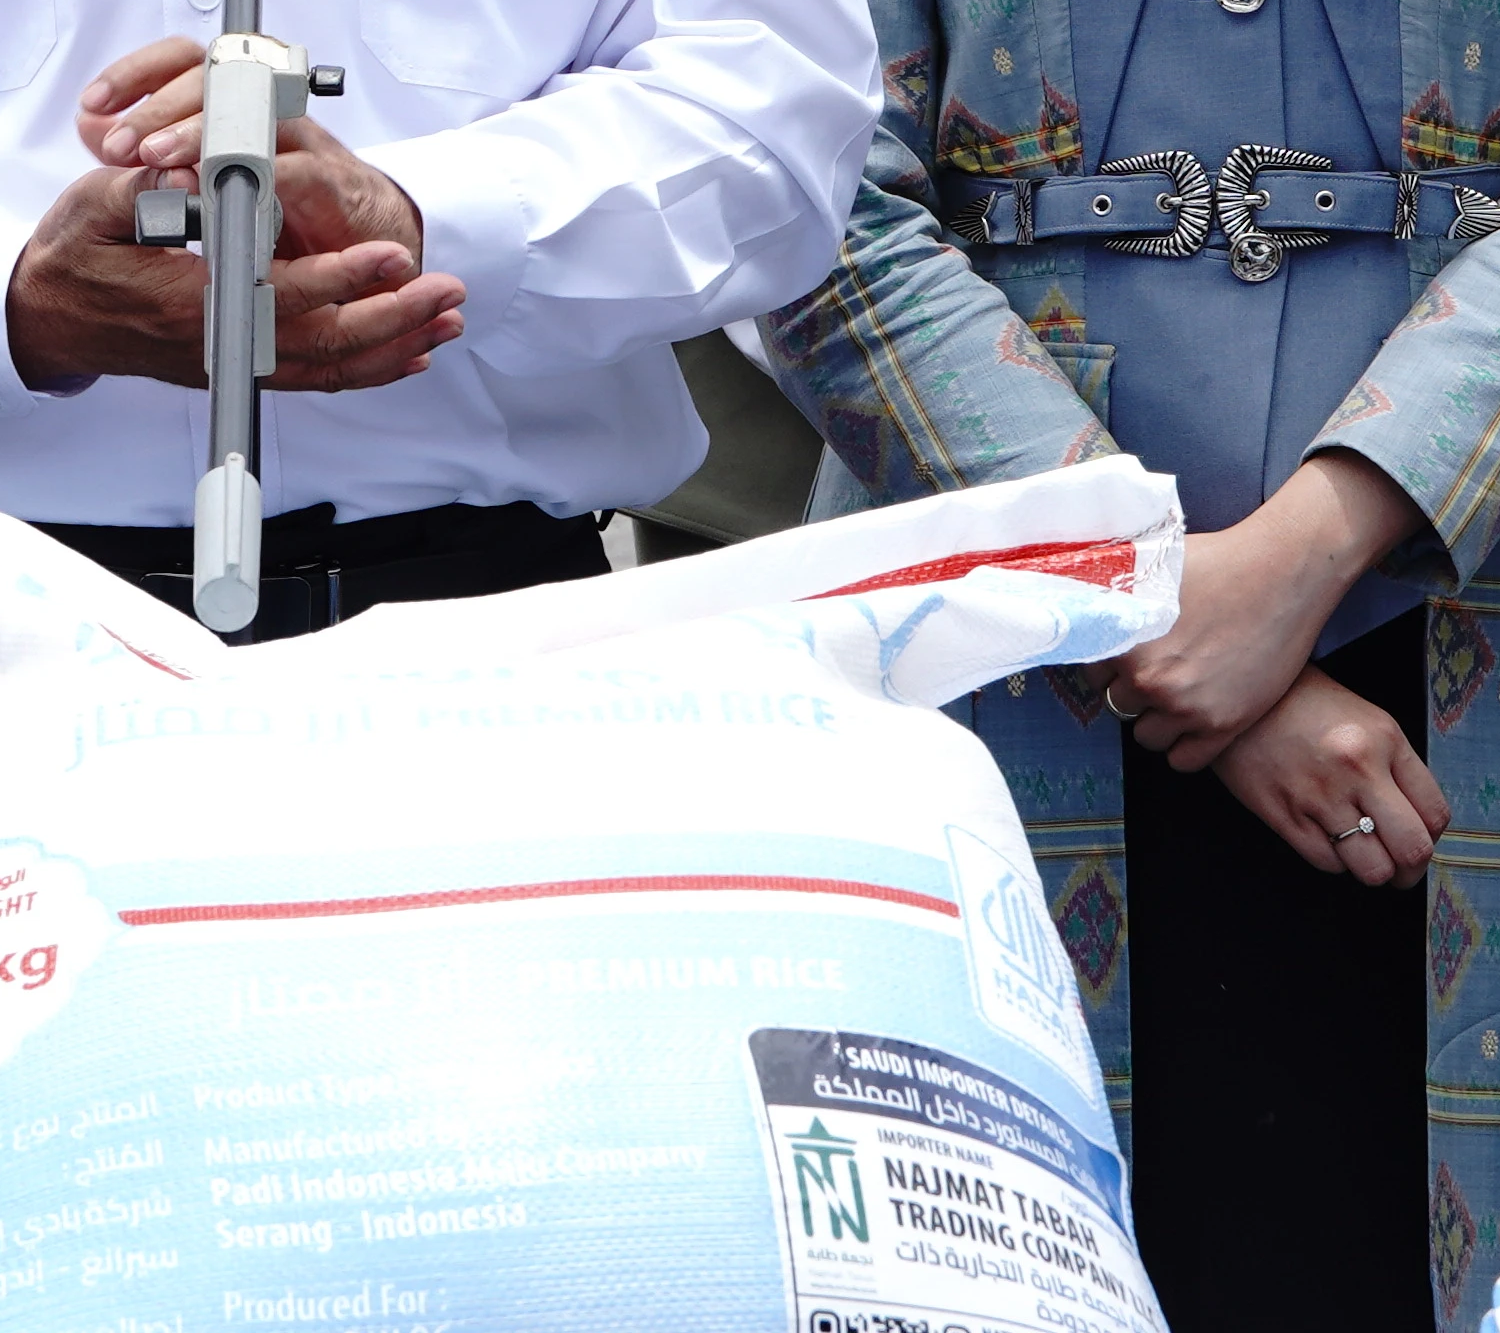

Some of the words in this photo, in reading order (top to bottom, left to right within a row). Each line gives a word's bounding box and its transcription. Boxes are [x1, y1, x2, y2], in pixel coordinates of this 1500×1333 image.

[515, 955, 739, 993] PREMIUM
[749, 955, 847, 991] RICE
[193, 1079, 314, 1111] Product
[849, 1046, 912, 1078] SAUDI
[914, 1057, 1010, 1116] IMPORTER
[203, 1117, 426, 1169] Manufactured
[877, 1127, 951, 1159] IMPORTER
[953, 1147, 995, 1171] NAME
[209, 1173, 284, 1209] Padi
[290, 1161, 457, 1203] Indonesia
[555, 1144, 708, 1179] Company
[214, 1217, 335, 1255] Serang
[361, 1199, 528, 1246] Indonesia
[884, 1157, 1006, 1216] NAJMAT
[1013, 1190, 1102, 1258] TABAH
[889, 1197, 1016, 1252] TRADING
[1021, 1231, 1135, 1308] COMPANY
[222, 1279, 372, 1325] Produced
[379, 1281, 430, 1317] For
